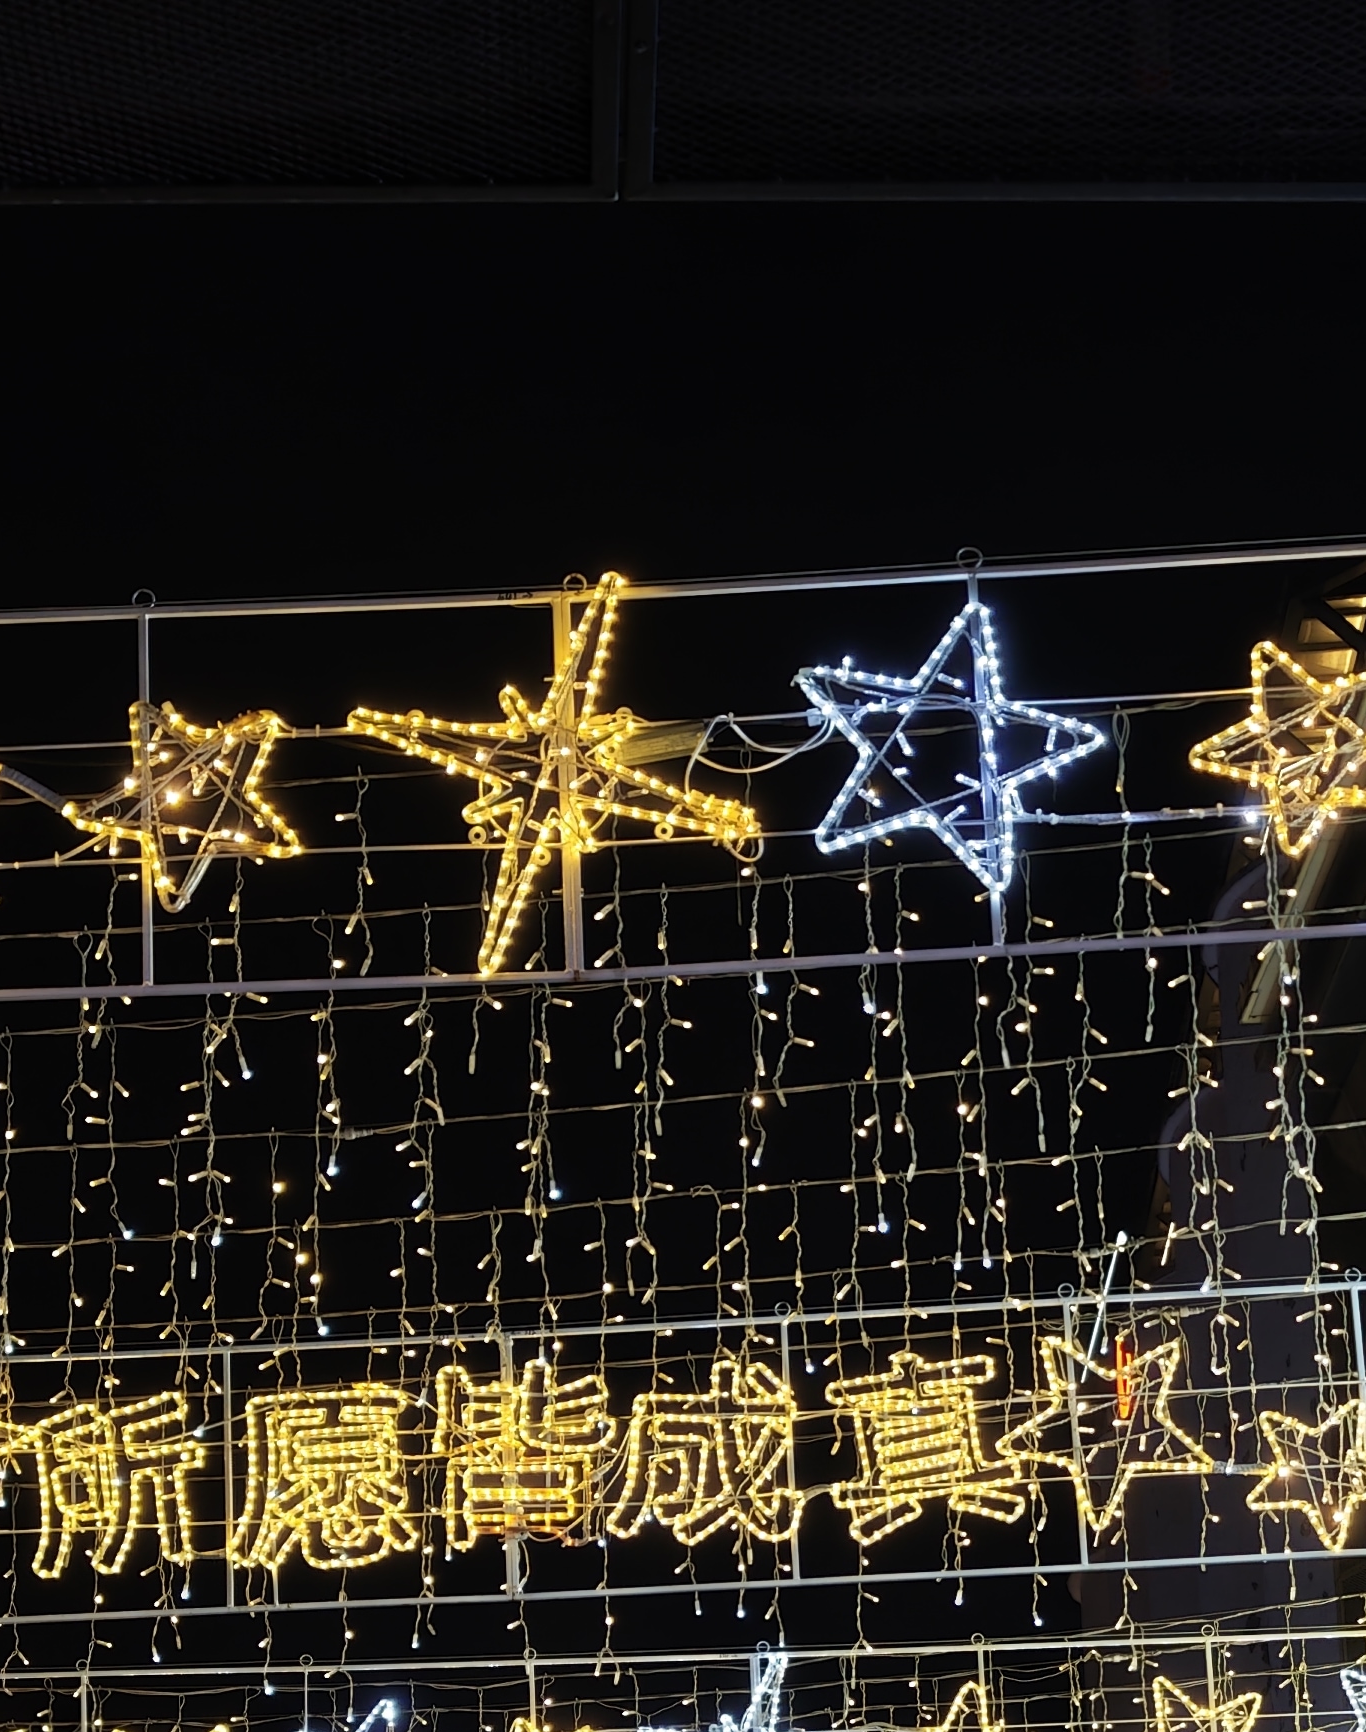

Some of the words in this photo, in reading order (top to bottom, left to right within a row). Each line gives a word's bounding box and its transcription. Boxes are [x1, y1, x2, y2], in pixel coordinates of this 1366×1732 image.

[35, 1352, 1026, 1579] 所愿皆成真
